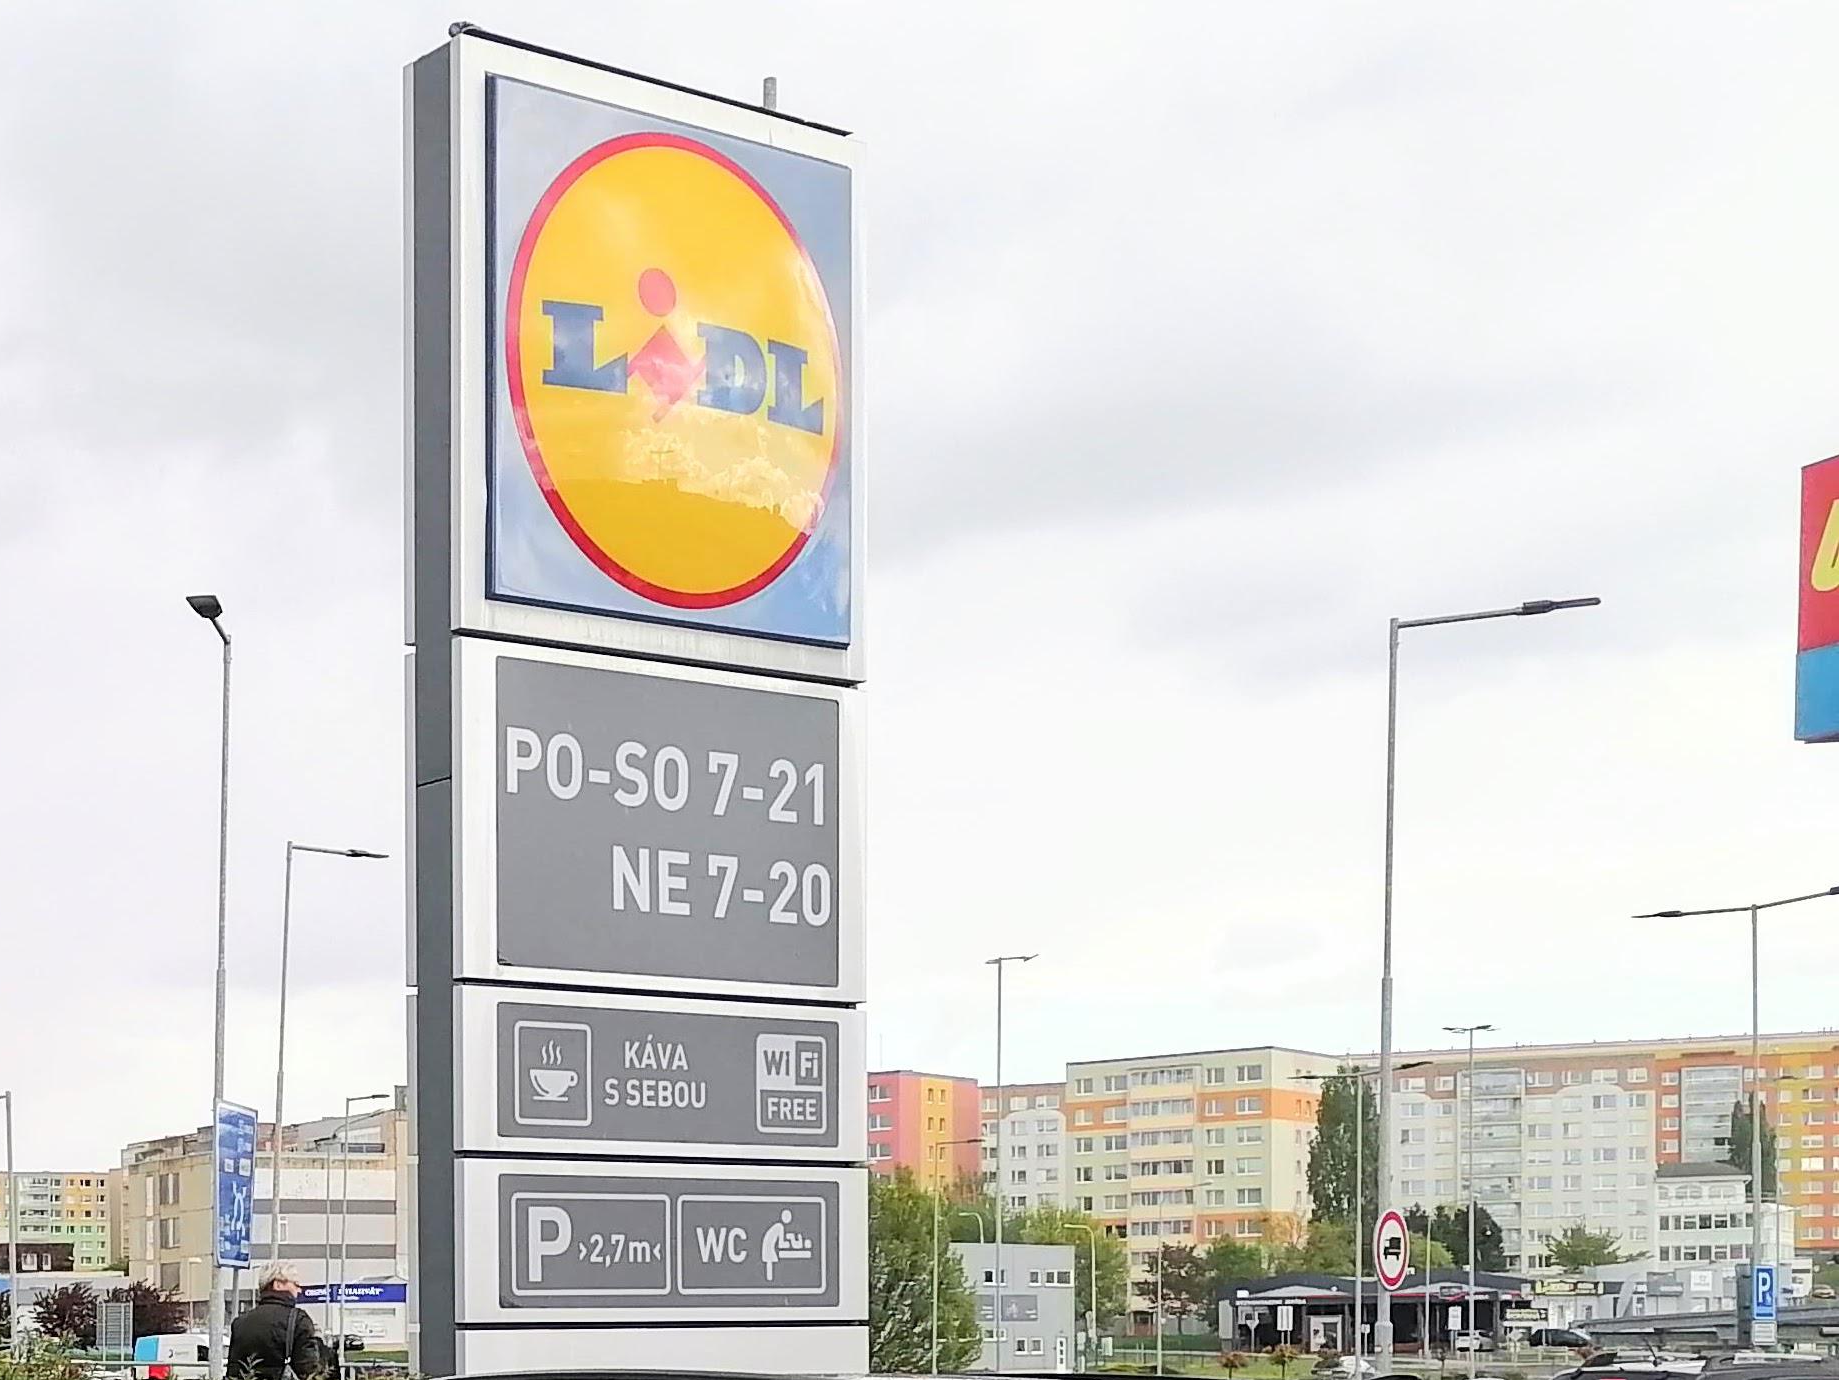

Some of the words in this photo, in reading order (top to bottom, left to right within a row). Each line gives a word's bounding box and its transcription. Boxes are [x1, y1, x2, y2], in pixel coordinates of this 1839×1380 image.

[542, 268, 823, 436] LIDL
[504, 725, 689, 812] PO-SO
[708, 751, 824, 826] 7-21
[612, 845, 691, 916] NE
[708, 854, 831, 927] 7-20
[624, 1034, 689, 1071] KÁVA
[604, 1078, 620, 1106] S
[625, 1080, 707, 1109] SEBOU
[767, 1097, 817, 1121] FREE
[527, 1206, 573, 1282] P
[696, 1227, 748, 1264] WC
[1758, 1272, 1771, 1303] P
